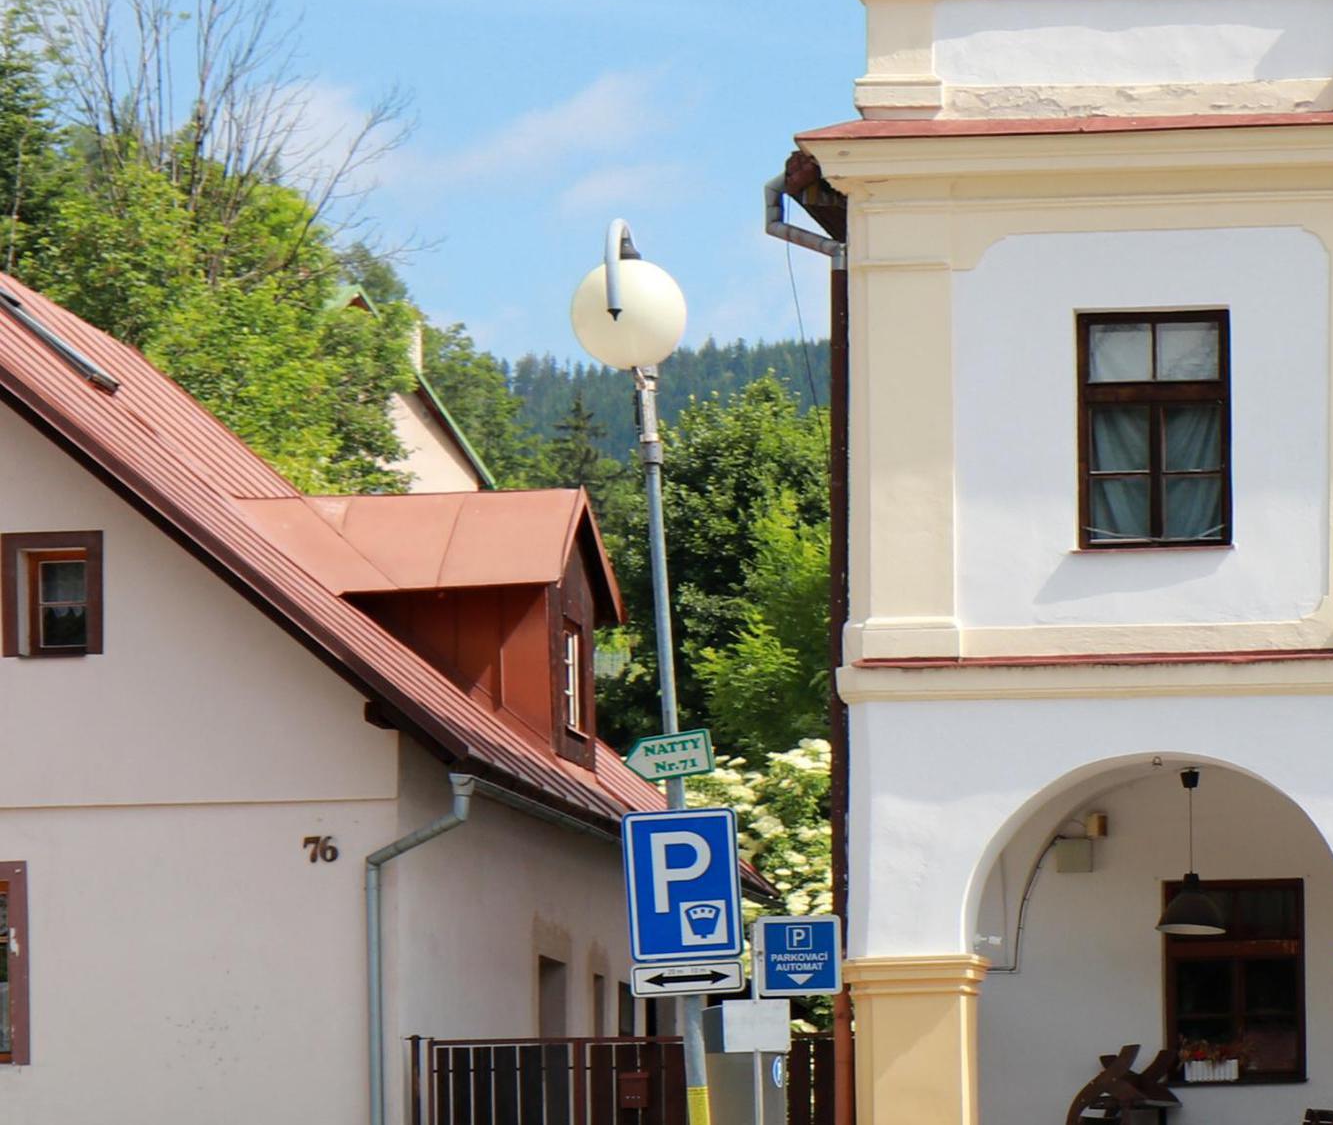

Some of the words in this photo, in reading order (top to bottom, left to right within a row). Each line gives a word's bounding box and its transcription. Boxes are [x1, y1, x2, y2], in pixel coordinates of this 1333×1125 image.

[643, 738, 701, 756] NATTY
[655, 758, 697, 773] Nr.71
[303, 836, 338, 863] 76
[650, 831, 712, 913] P
[792, 929, 806, 947] P
[771, 951, 828, 962] PARKOVACÍ
[776, 962, 823, 971] AUTOMAT
